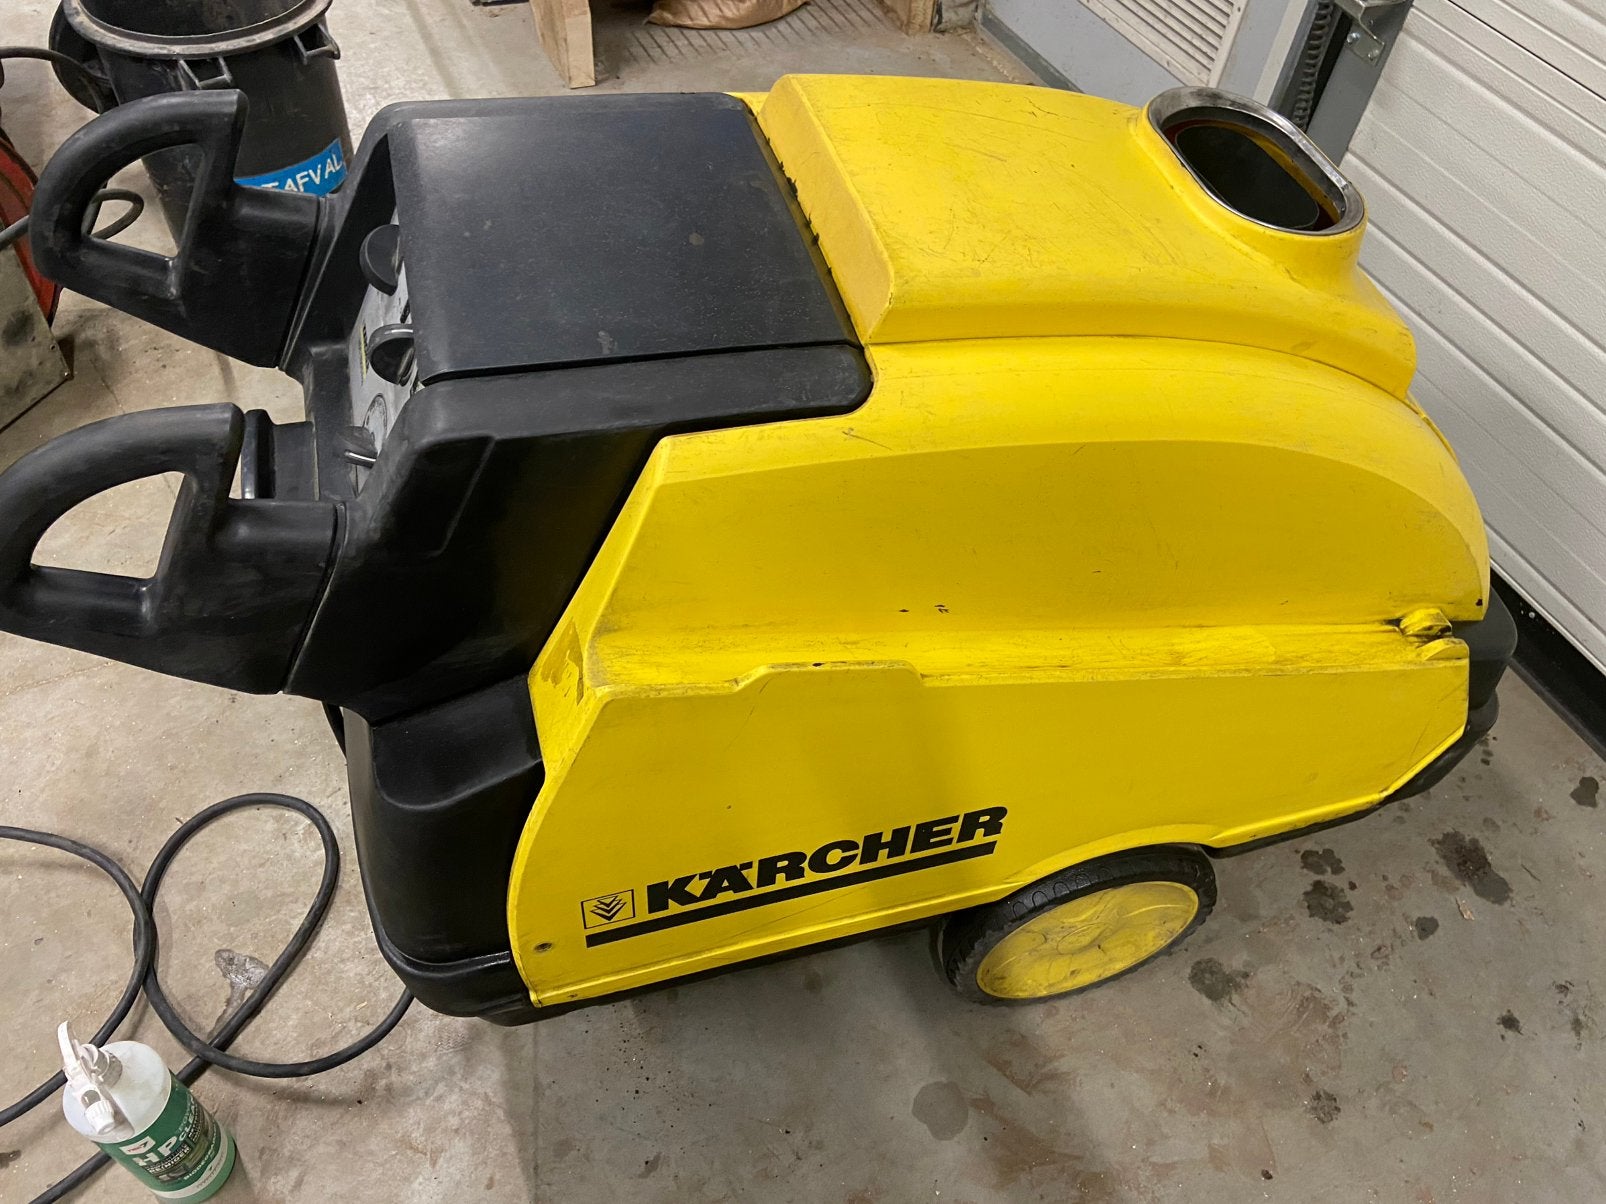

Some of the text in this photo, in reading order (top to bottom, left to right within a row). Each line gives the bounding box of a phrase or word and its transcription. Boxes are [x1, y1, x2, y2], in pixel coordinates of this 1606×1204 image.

[261, 153, 343, 193] AFVAL
[646, 806, 1008, 914] KÄRCHER
[132, 1136, 178, 1166] HP
